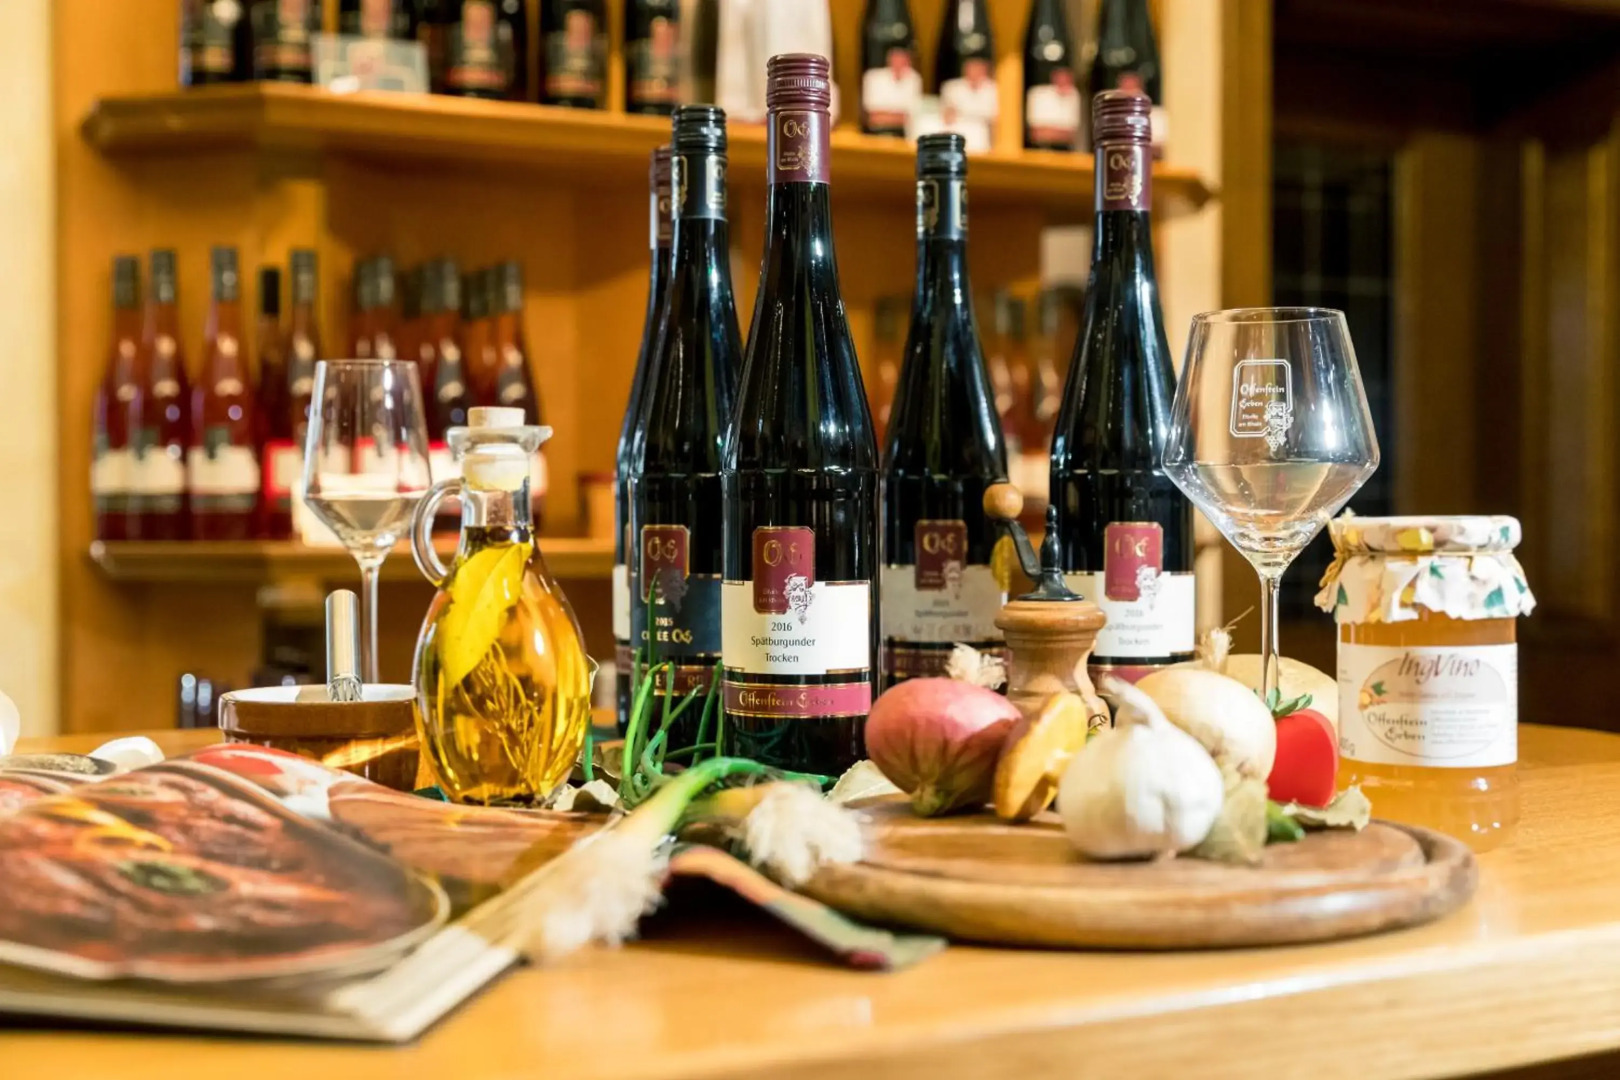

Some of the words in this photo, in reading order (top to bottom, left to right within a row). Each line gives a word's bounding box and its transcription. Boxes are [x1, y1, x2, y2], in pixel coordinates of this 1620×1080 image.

[771, 621, 792, 632] 2016
[751, 635, 816, 648] Spätburgunder
[765, 652, 799, 663] Trocken
[1397, 651, 1481, 686] IngVino
